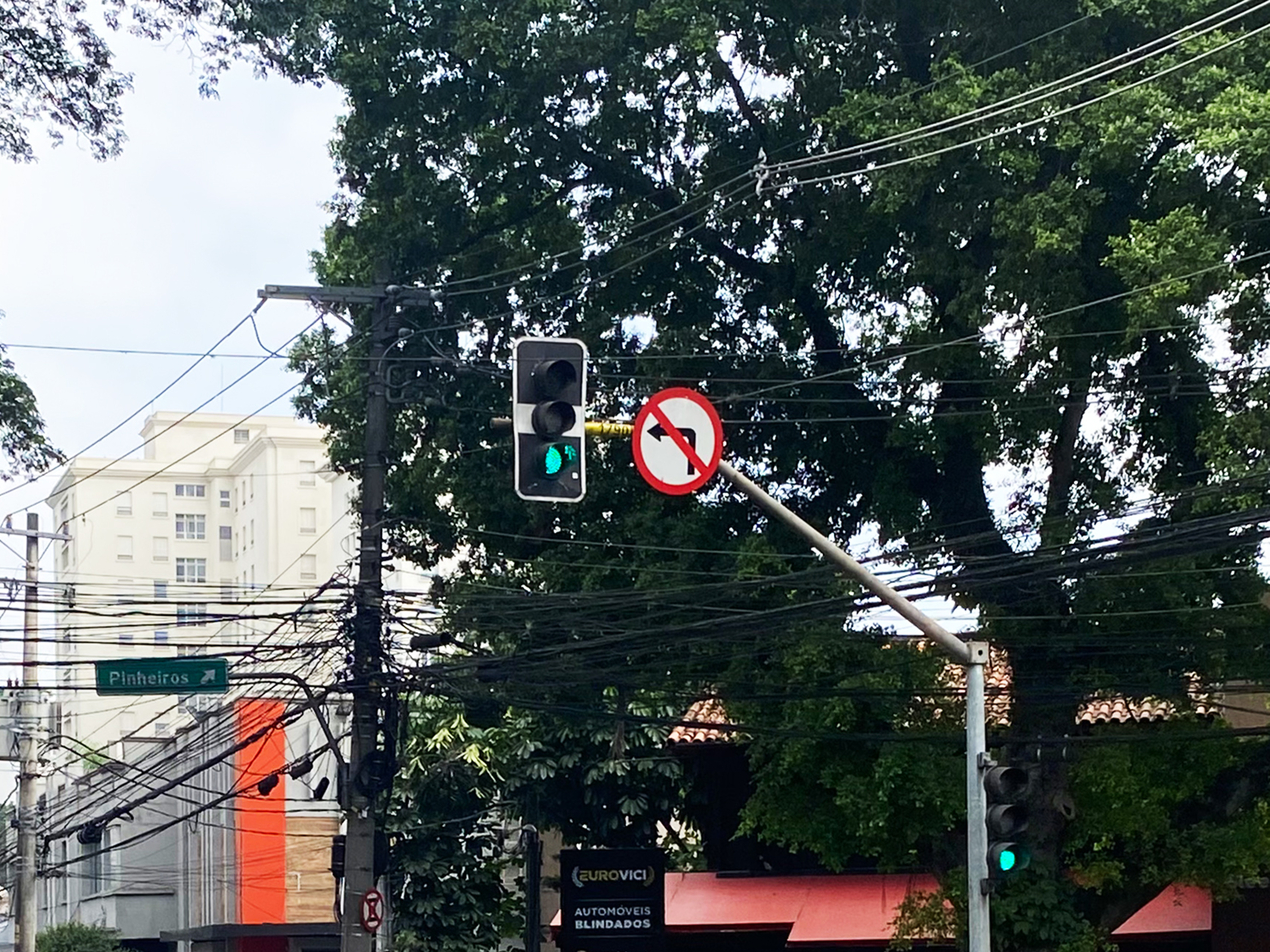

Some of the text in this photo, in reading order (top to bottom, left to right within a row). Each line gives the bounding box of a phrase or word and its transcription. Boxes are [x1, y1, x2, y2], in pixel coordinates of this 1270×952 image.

[110, 671, 189, 686] Pinheiros
[578, 869, 647, 882] EUROVICI
[574, 905, 651, 917] AUTOMÓVEIS
[574, 919, 651, 930] BLINDADOS
